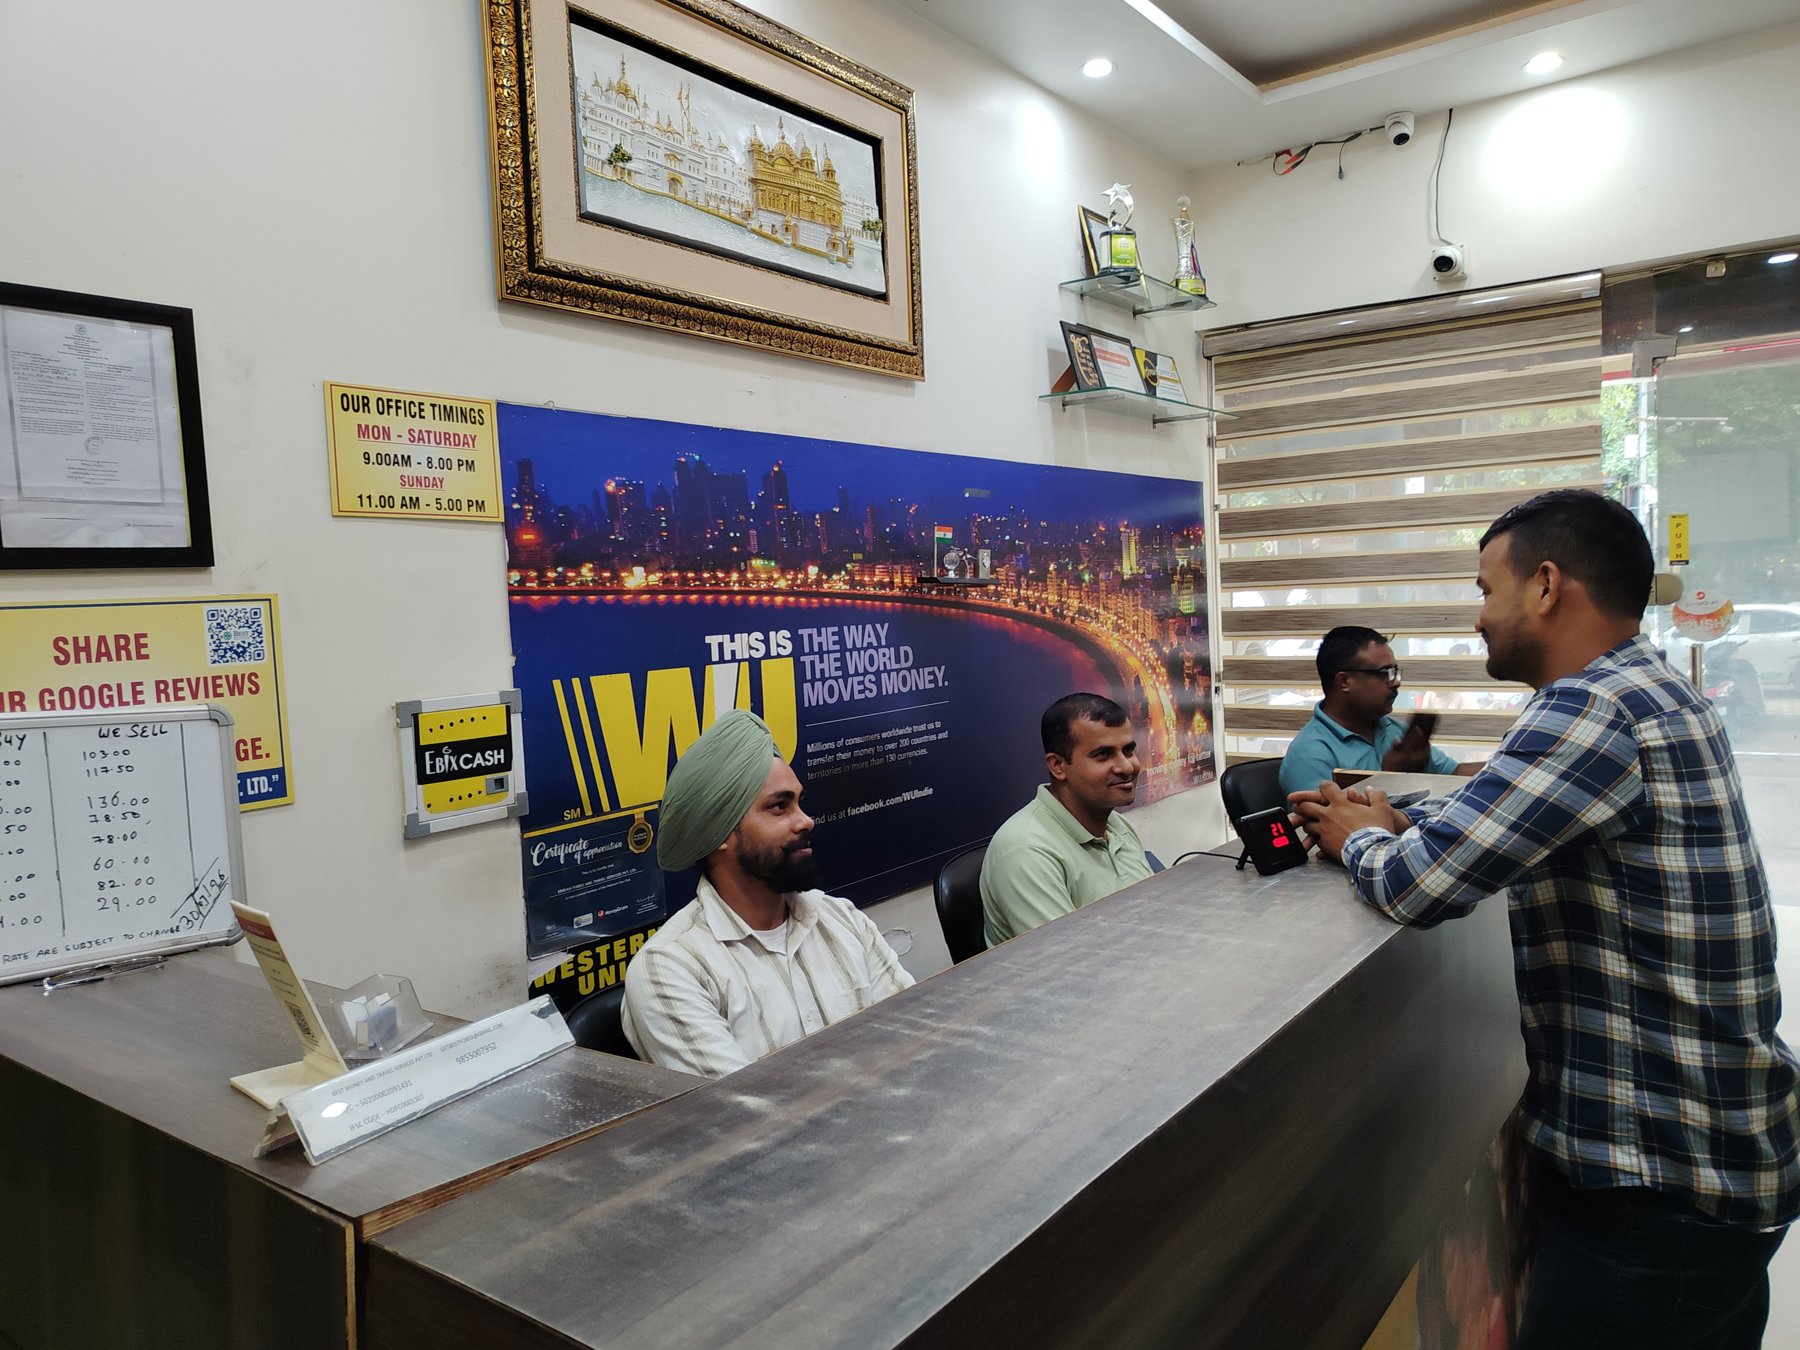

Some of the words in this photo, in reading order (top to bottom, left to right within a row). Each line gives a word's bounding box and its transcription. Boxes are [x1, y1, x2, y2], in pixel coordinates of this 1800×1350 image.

[340, 393, 371, 414] OUR
[376, 397, 425, 420] OFFICE
[430, 403, 485, 426] TIMINGS
[357, 423, 391, 441] MON
[408, 428, 477, 449] SATURDAY
[363, 451, 411, 468] 9.00AM
[427, 456, 453, 471] 8.00
[458, 459, 475, 472] PM
[400, 475, 444, 489] SUNDAY
[357, 494, 395, 509] 11.00
[400, 496, 420, 510] AM
[435, 498, 462, 512] 5.00
[467, 500, 486, 513] PM
[1675, 523, 1683, 560] PUSH
[52, 632, 150, 666] SHARE
[704, 631, 766, 662] THIS
[769, 629, 793, 656] IS
[798, 626, 840, 653] THE
[843, 622, 889, 649] WAY
[800, 652, 841, 680] THE
[845, 645, 914, 676] WORLD
[38, 681, 146, 712] GOOGLE
[154, 672, 260, 704] REVIEWS
[803, 675, 877, 707] MOVES
[881, 665, 949, 696] MONEY.
[98, 726, 121, 738] WE
[126, 724, 168, 738] SELL
[807, 740, 835, 753] Millions
[836, 738, 844, 748] of
[845, 732, 880, 746] consumers
[881, 725, 912, 739] worldwide
[913, 722, 927, 732] trust
[927, 722, 934, 730] us
[935, 720, 942, 728] to
[807, 753, 835, 767] transfer
[836, 749, 852, 761] their
[853, 746, 876, 758] money
[876, 744, 883, 753] to
[884, 741, 898, 751] over
[899, 737, 910, 748] 200
[910, 733, 937, 745] countries
[937, 729, 949, 739] and
[86, 765, 134, 778] 117.50
[807, 766, 842, 781] territories
[843, 763, 850, 773] in
[851, 760, 869, 771] more
[869, 757, 884, 767] than
[885, 753, 897, 763] 130
[87, 790, 150, 809] 136.00
[564, 808, 580, 821] SM
[827, 812, 837, 822] us
[838, 809, 846, 819] at
[92, 830, 137, 844] 78.00
[1270, 822, 1285, 836] 21
[531, 838, 589, 867] Certificate
[583, 841, 623, 860] appreciation
[93, 856, 150, 871] 60.00
[97, 876, 155, 891] 82.00
[97, 895, 157, 912] 29.00
[2, 952, 30, 964] RATE
[36, 947, 58, 957] ARE
[65, 936, 115, 952] SUBJECT
[139, 924, 181, 939] CHANGE
[456, 1042, 498, 1065] 9855007952
